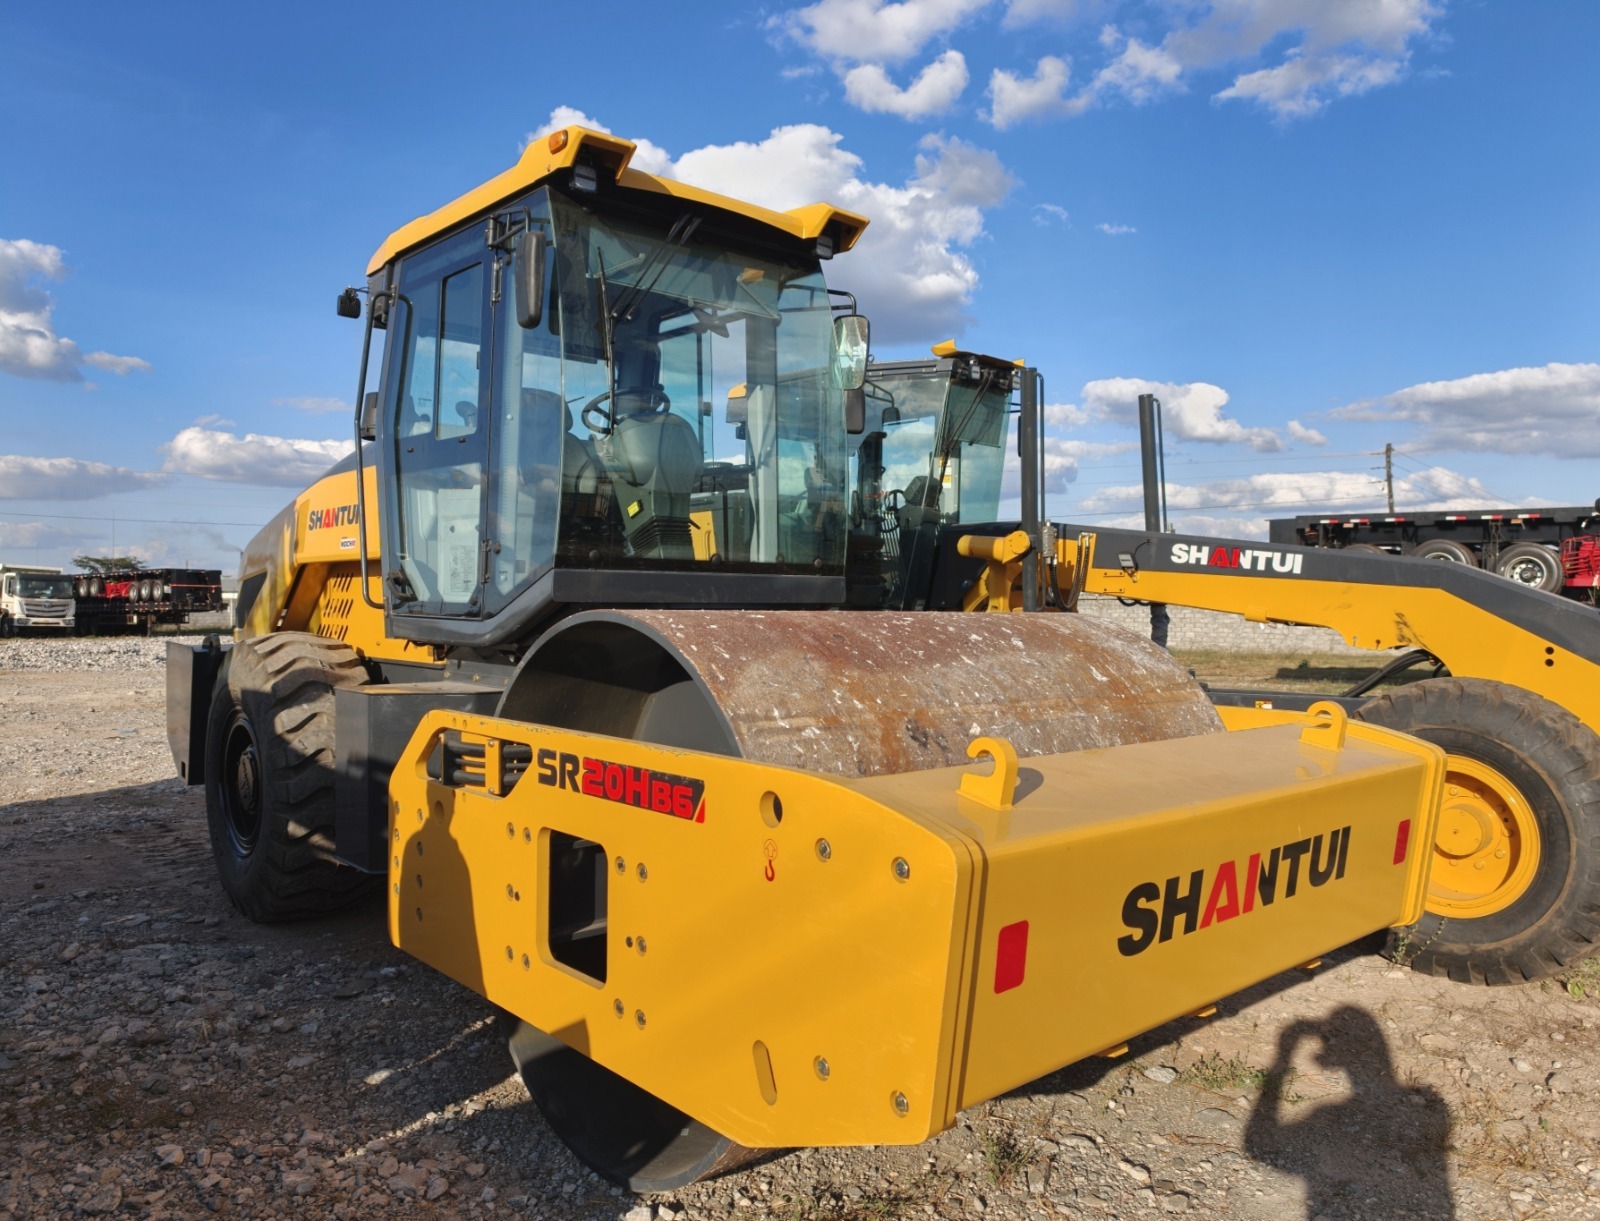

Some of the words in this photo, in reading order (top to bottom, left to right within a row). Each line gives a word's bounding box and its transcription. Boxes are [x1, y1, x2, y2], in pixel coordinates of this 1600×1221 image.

[1170, 543, 1303, 574] SHANTUI
[537, 748, 693, 819] SR20HB6
[1117, 825, 1352, 957] SHANTUI
